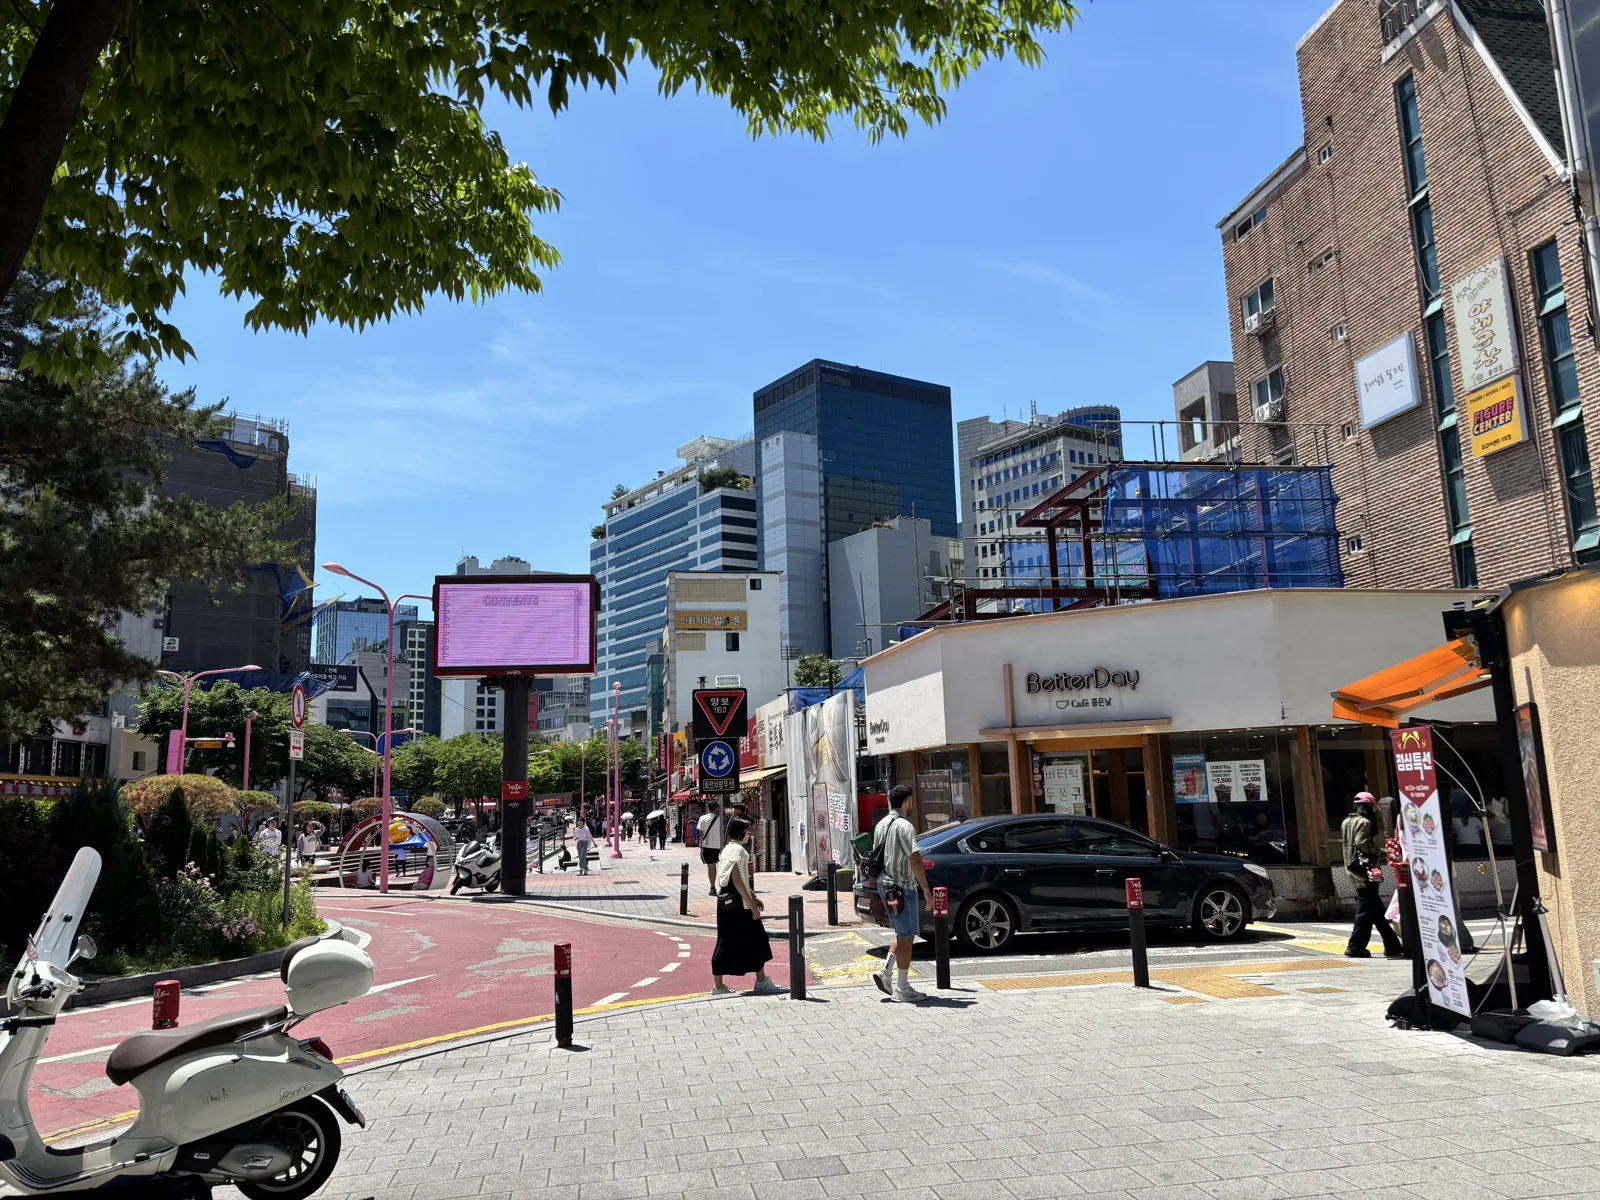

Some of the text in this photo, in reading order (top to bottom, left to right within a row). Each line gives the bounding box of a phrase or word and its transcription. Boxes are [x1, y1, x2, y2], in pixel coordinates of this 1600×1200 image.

[1468, 298, 1502, 371] 야채곱창
[1474, 397, 1514, 424] FIGURE
[1473, 411, 1512, 436] CENTER
[482, 594, 540, 607] CONTENTS
[680, 616, 711, 626] 만화카페
[1025, 667, 1140, 693] BetterDay
[1071, 696, 1112, 708] Café 좋은날
[1396, 752, 1432, 772] 점심특선
[1046, 768, 1078, 780] 버터떡
[704, 781, 734, 790] 회전차량우선
[1046, 786, 1081, 802] 두쫀쿠
[279, 1084, 314, 1101] Vespa
